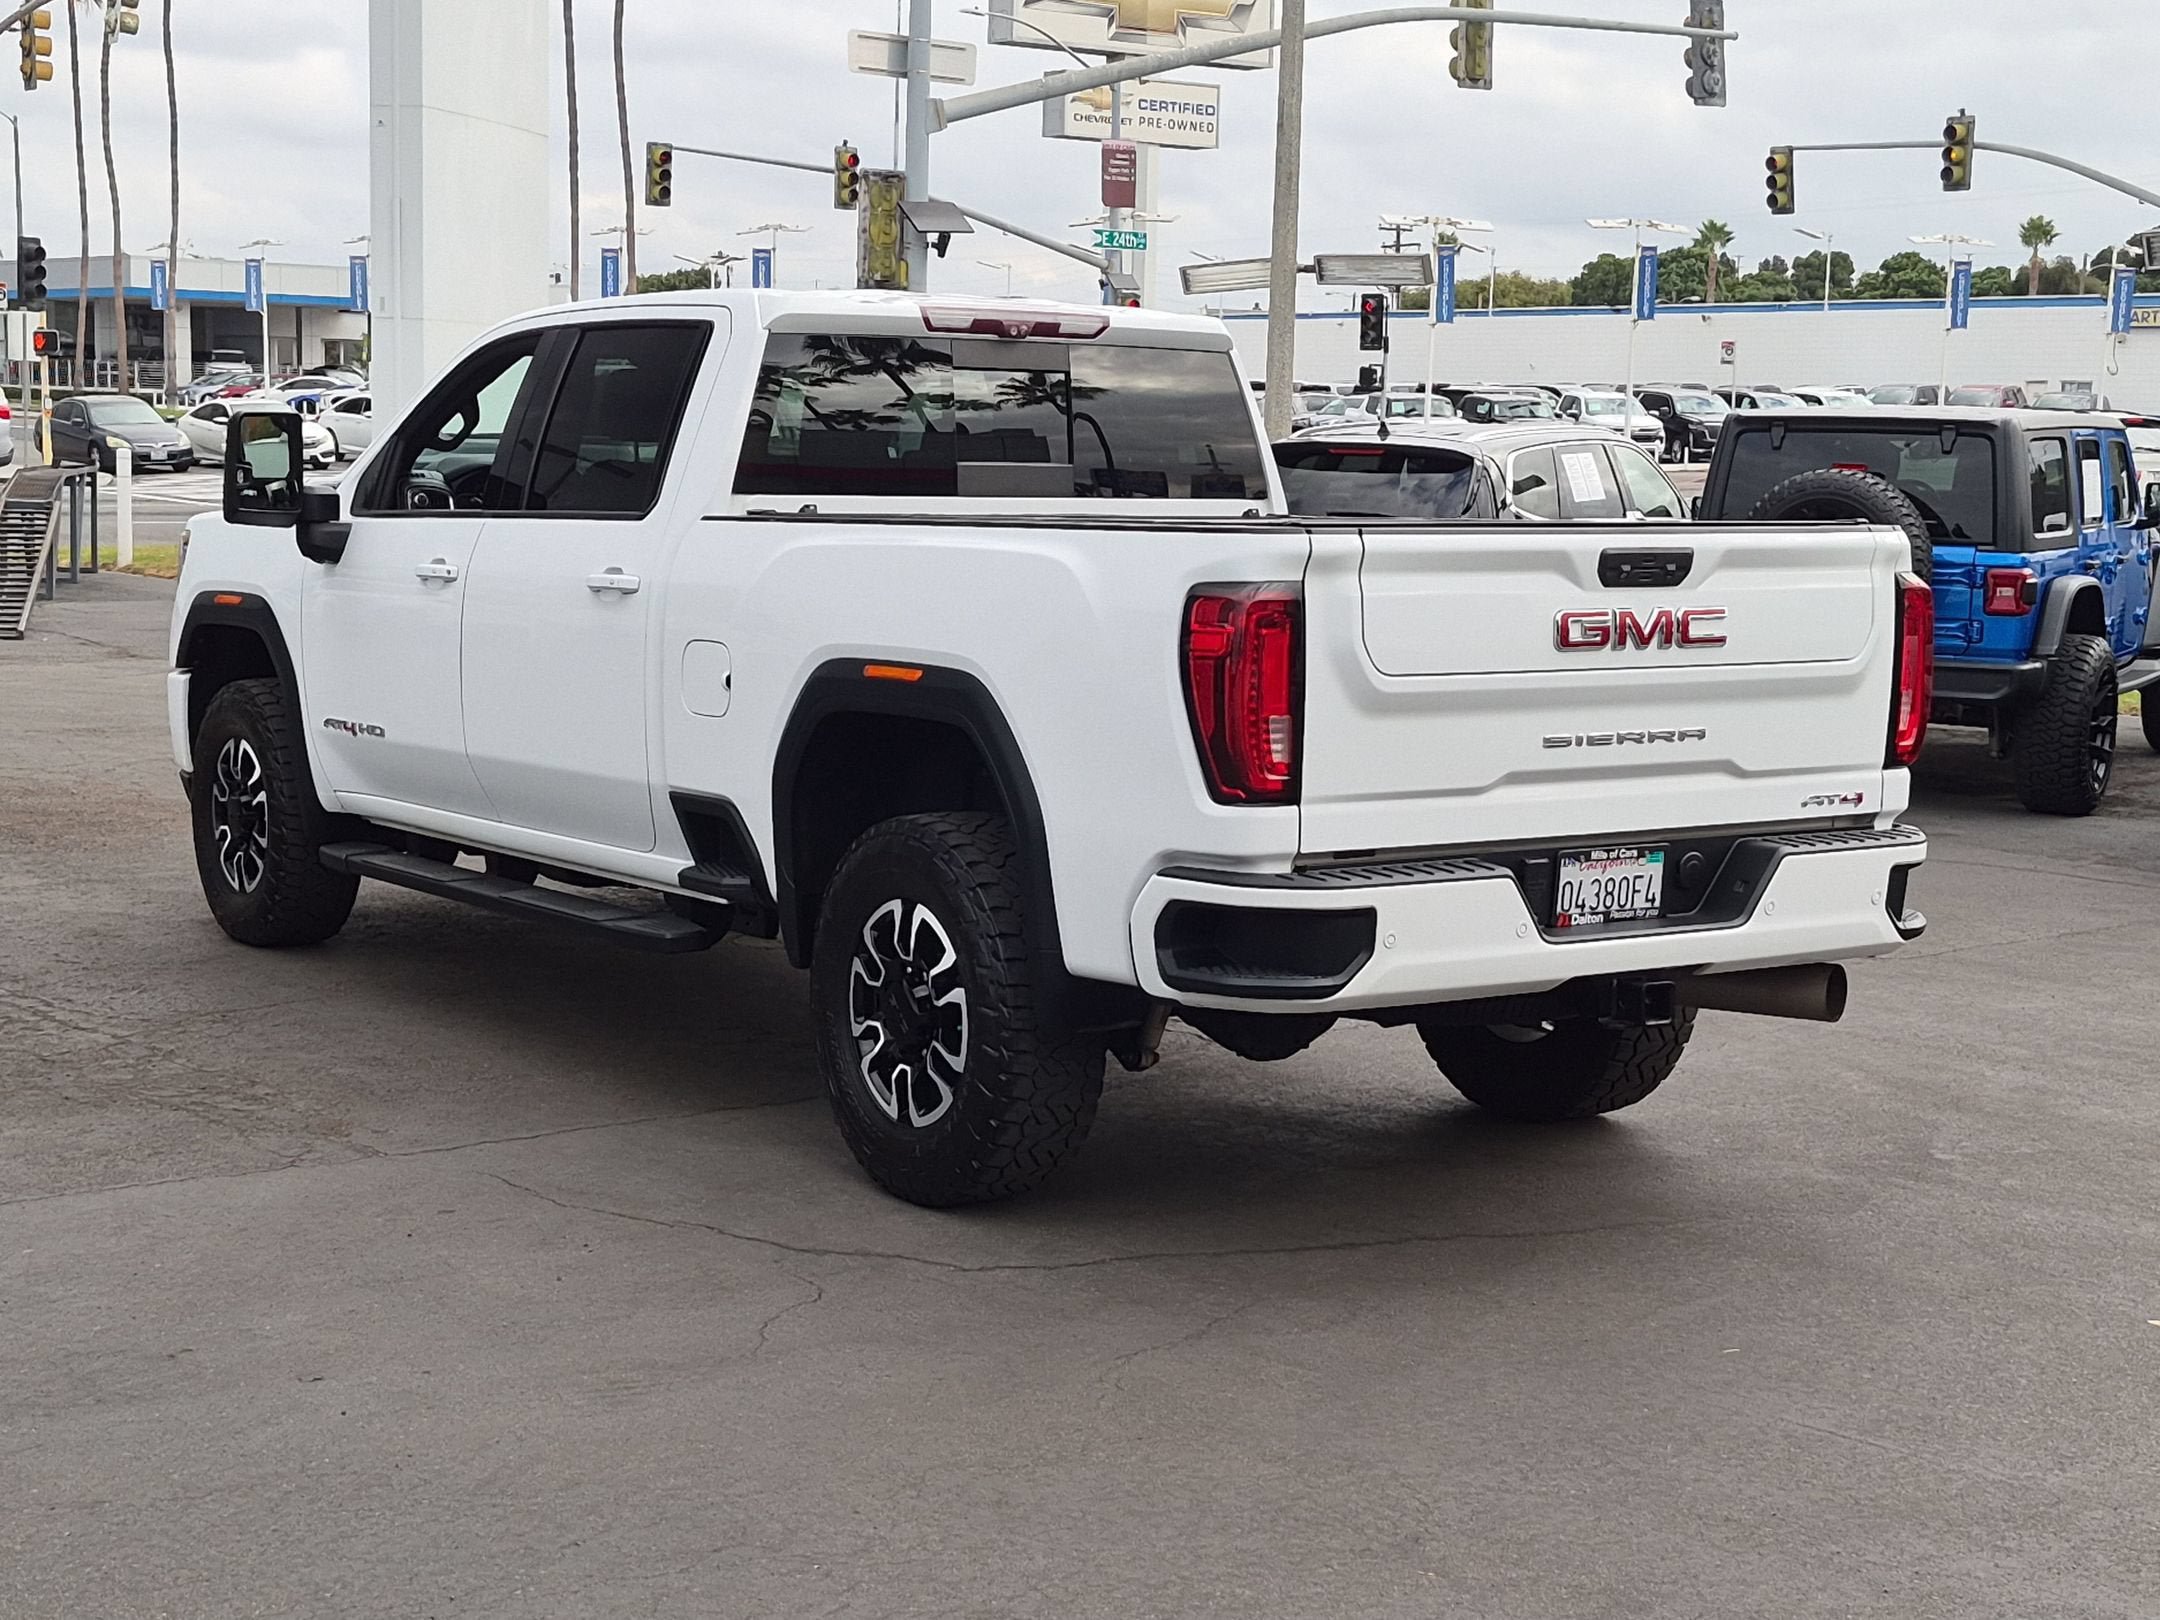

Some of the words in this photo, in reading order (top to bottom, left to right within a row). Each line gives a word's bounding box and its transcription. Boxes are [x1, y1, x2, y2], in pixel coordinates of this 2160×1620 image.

[1138, 99, 1215, 115] CERTIFIED
[1073, 113, 1133, 125] CHEVRET
[1139, 116, 1214, 133] PRE-OWNED
[1102, 231, 1111, 246] E
[1112, 232, 1137, 247] 24th
[1553, 606, 1728, 652] GMC
[1542, 728, 1707, 750] SIERRA
[1800, 791, 1865, 809] AT4
[1609, 849, 1618, 859] of
[1619, 848, 1638, 858] Cars
[1561, 875, 1656, 912] 04380F4
[1571, 913, 1604, 926] Dalton
